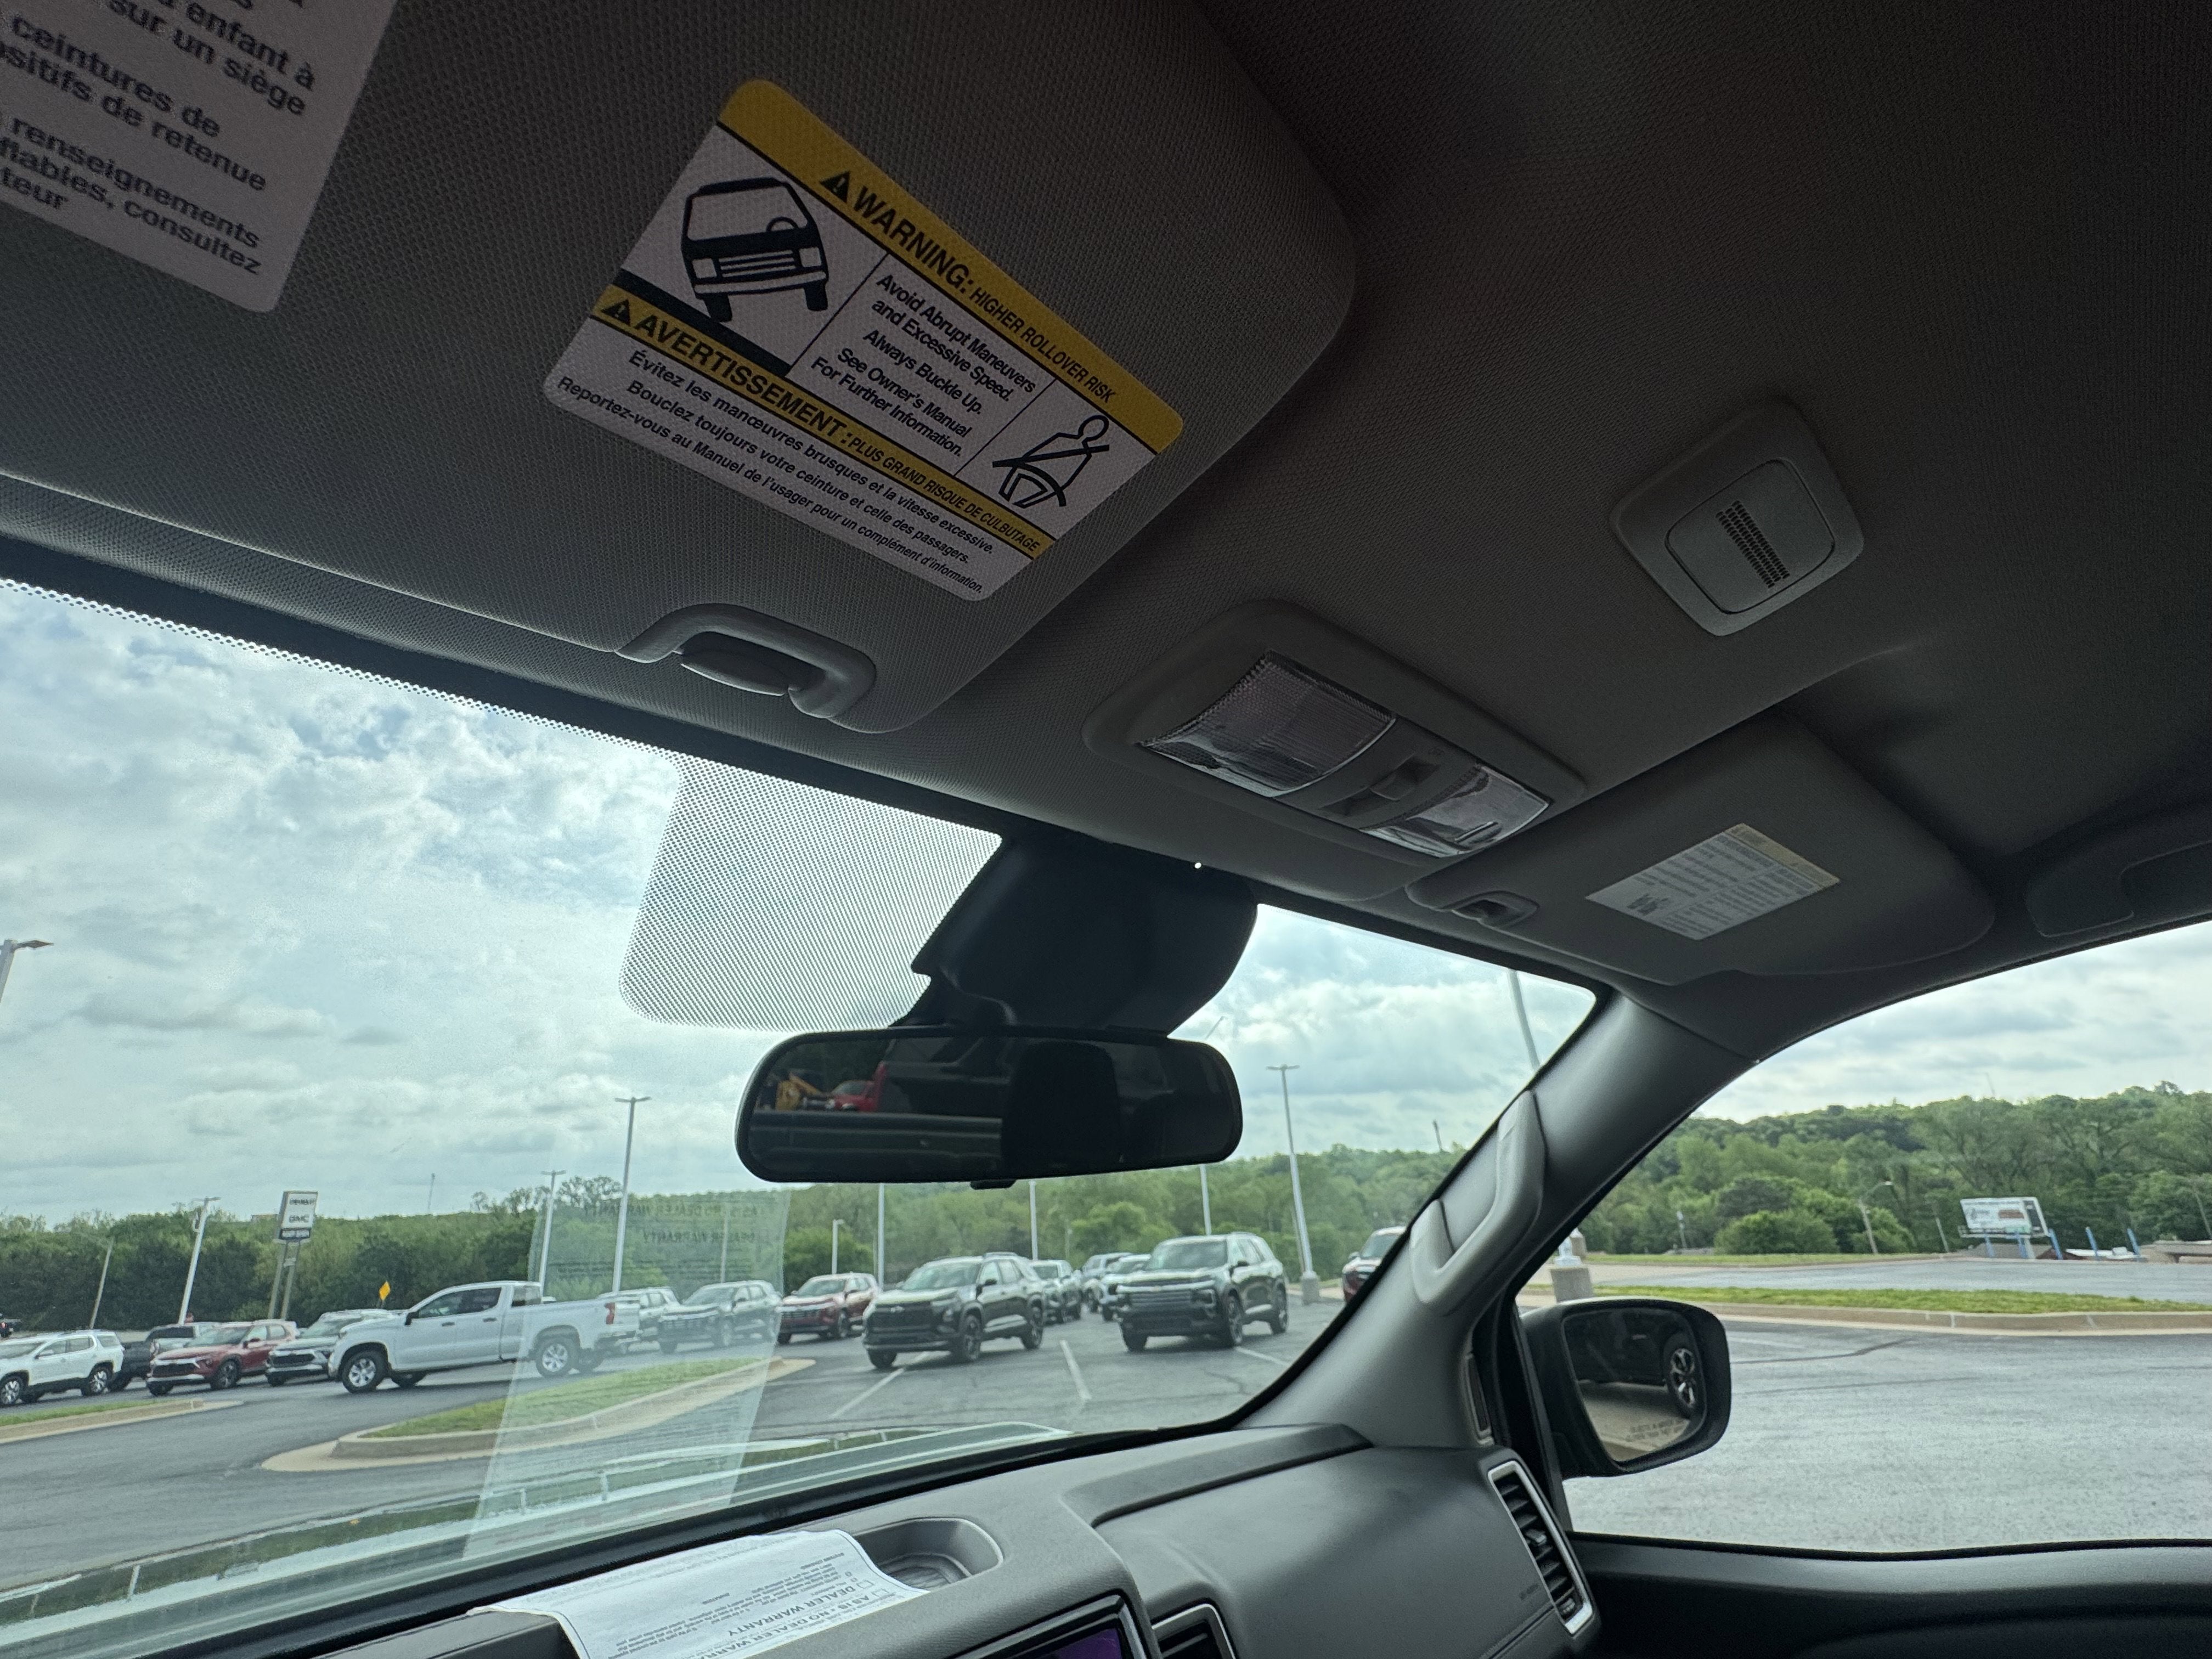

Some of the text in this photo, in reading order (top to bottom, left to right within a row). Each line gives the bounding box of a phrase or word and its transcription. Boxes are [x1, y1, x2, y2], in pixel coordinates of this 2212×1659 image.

[13, 17, 219, 137] ceintures de
[173, 30, 215, 64] un
[222, 58, 305, 115] siège
[186, 2, 315, 91] enfant à
[12, 117, 260, 248] renseignements
[101, 95, 144, 127] de
[151, 122, 267, 191] retenue
[124, 201, 262, 274] consultez
[853, 185, 1116, 403] WARNING: HIGHER ROLLOVER RISK
[875, 274, 1036, 393] Avoid Abrupt Maneuvers
[837, 347, 973, 438] See Owner's Manual
[862, 329, 982, 415] Always Buckle Up.
[871, 300, 1014, 402] and Excessive Speed.
[628, 349, 685, 388] Évitez
[684, 380, 712, 402] les
[803, 443, 868, 485] brusques
[868, 481, 884, 494] et
[882, 487, 897, 501] la
[896, 495, 940, 523] vitesse
[938, 520, 993, 554] excessive.
[633, 314, 848, 437] AVERTISSEMENT
[847, 436, 884, 462] PLUS
[882, 456, 927, 486] GRAND
[922, 479, 968, 509] RISQUE
[962, 502, 983, 518] DE
[979, 512, 1041, 552] CULBUTAGE
[810, 356, 962, 457] For Further Information.
[557, 375, 672, 438] Reportez-vous
[670, 433, 692, 448] au
[691, 441, 746, 474] Manuel
[743, 468, 762, 483] de
[809, 503, 843, 522] pour
[840, 517, 858, 530] un
[857, 526, 923, 561] complément
[625, 379, 969, 564] Bouclez toujours votre ceinture et celle des passagers.
[729, 1605, 805, 1637] WARRANTY
[753, 1618, 809, 1641] DEALER
[804, 1585, 856, 1608] DEALER
